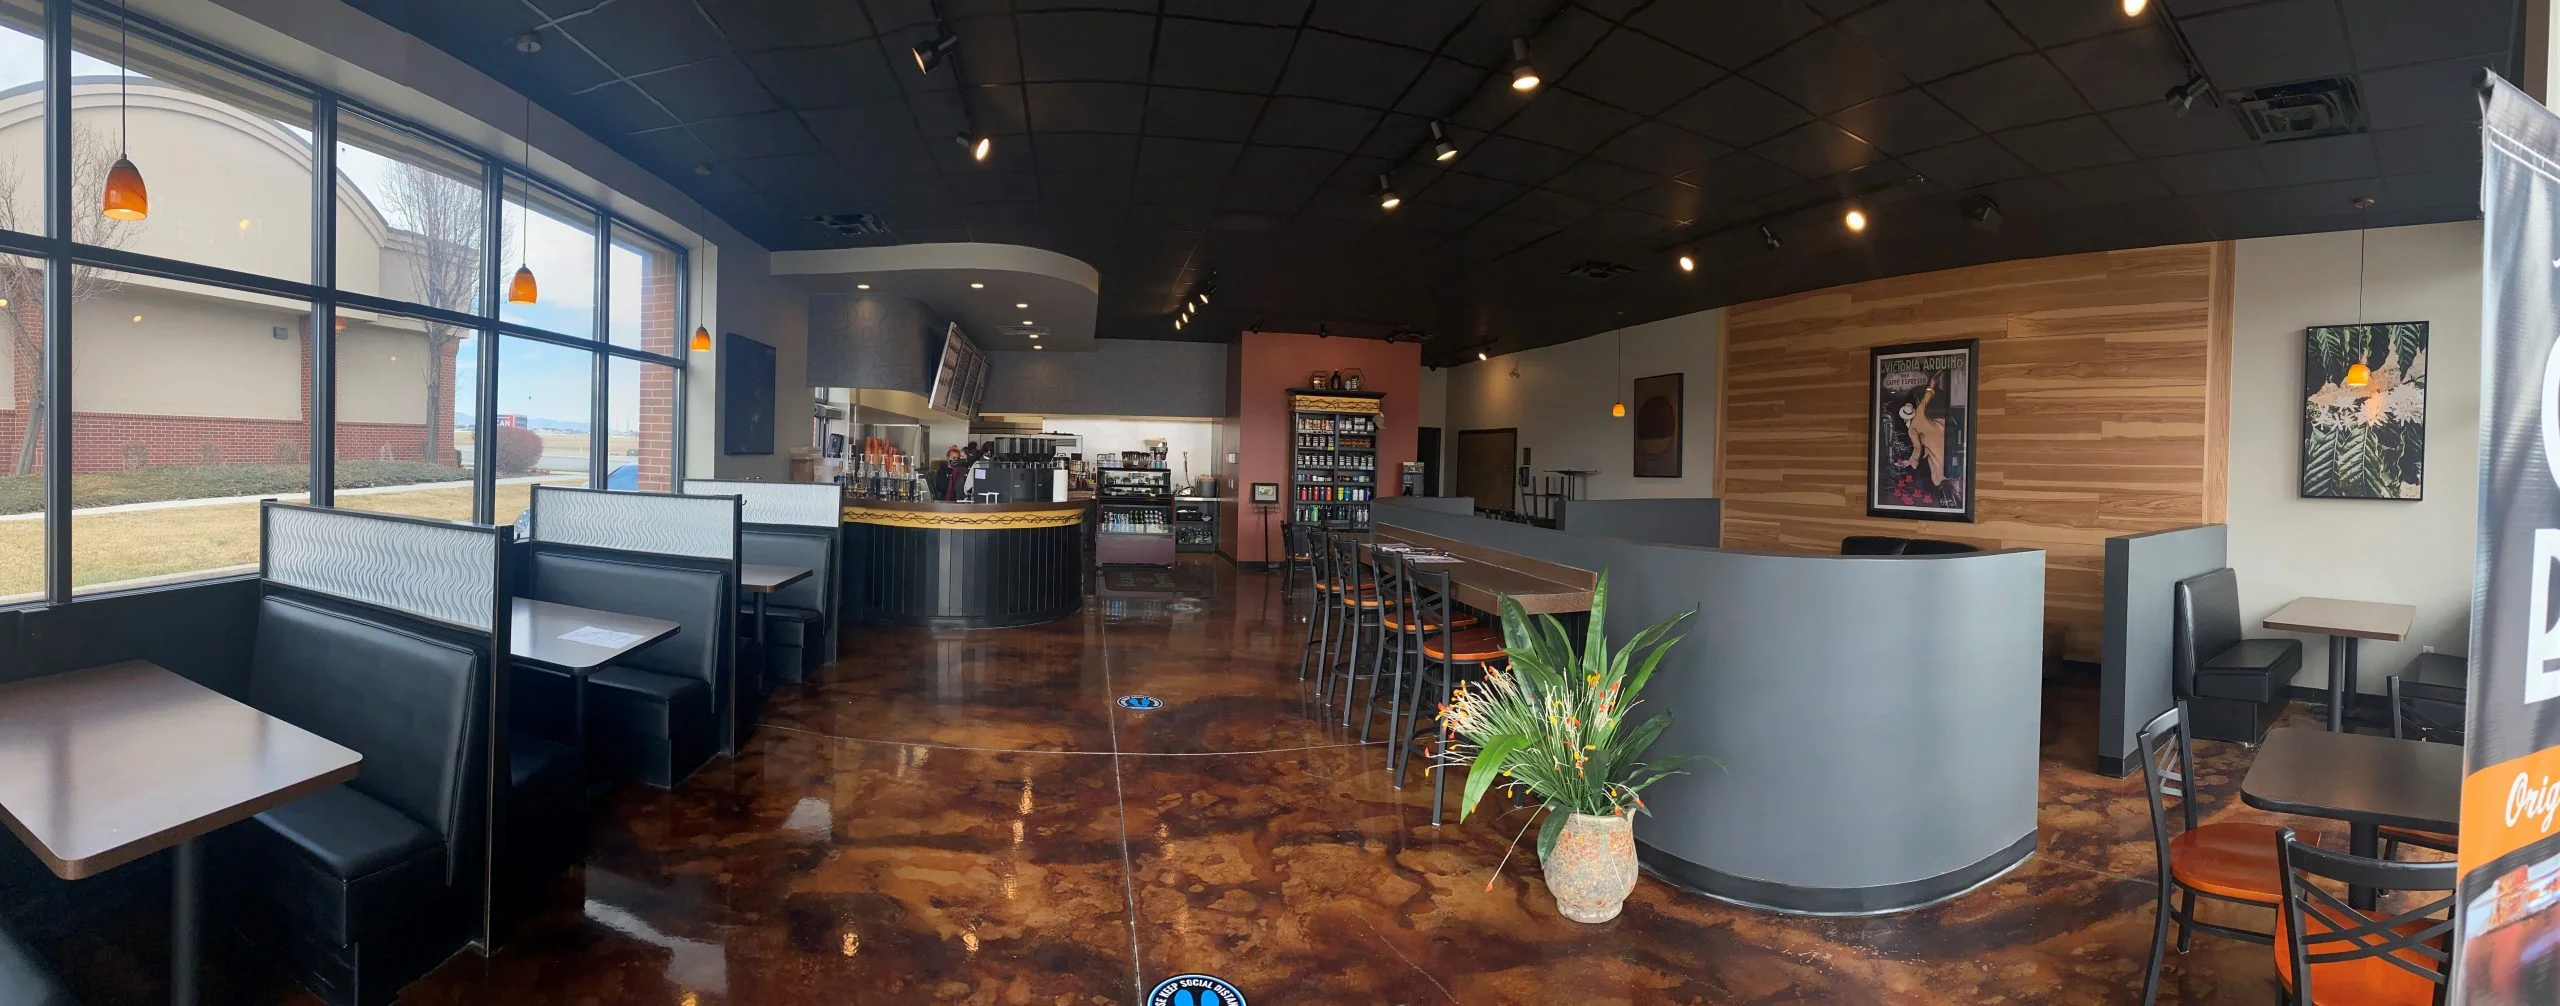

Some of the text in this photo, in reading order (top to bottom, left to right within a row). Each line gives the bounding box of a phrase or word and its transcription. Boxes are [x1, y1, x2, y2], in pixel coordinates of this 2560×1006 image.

[1885, 359, 1921, 373] VICTORIA
[1923, 357, 1963, 371] ARDUINO
[1159, 982, 1179, 998] KEEP
[1180, 979, 1213, 989] SOCIAL
